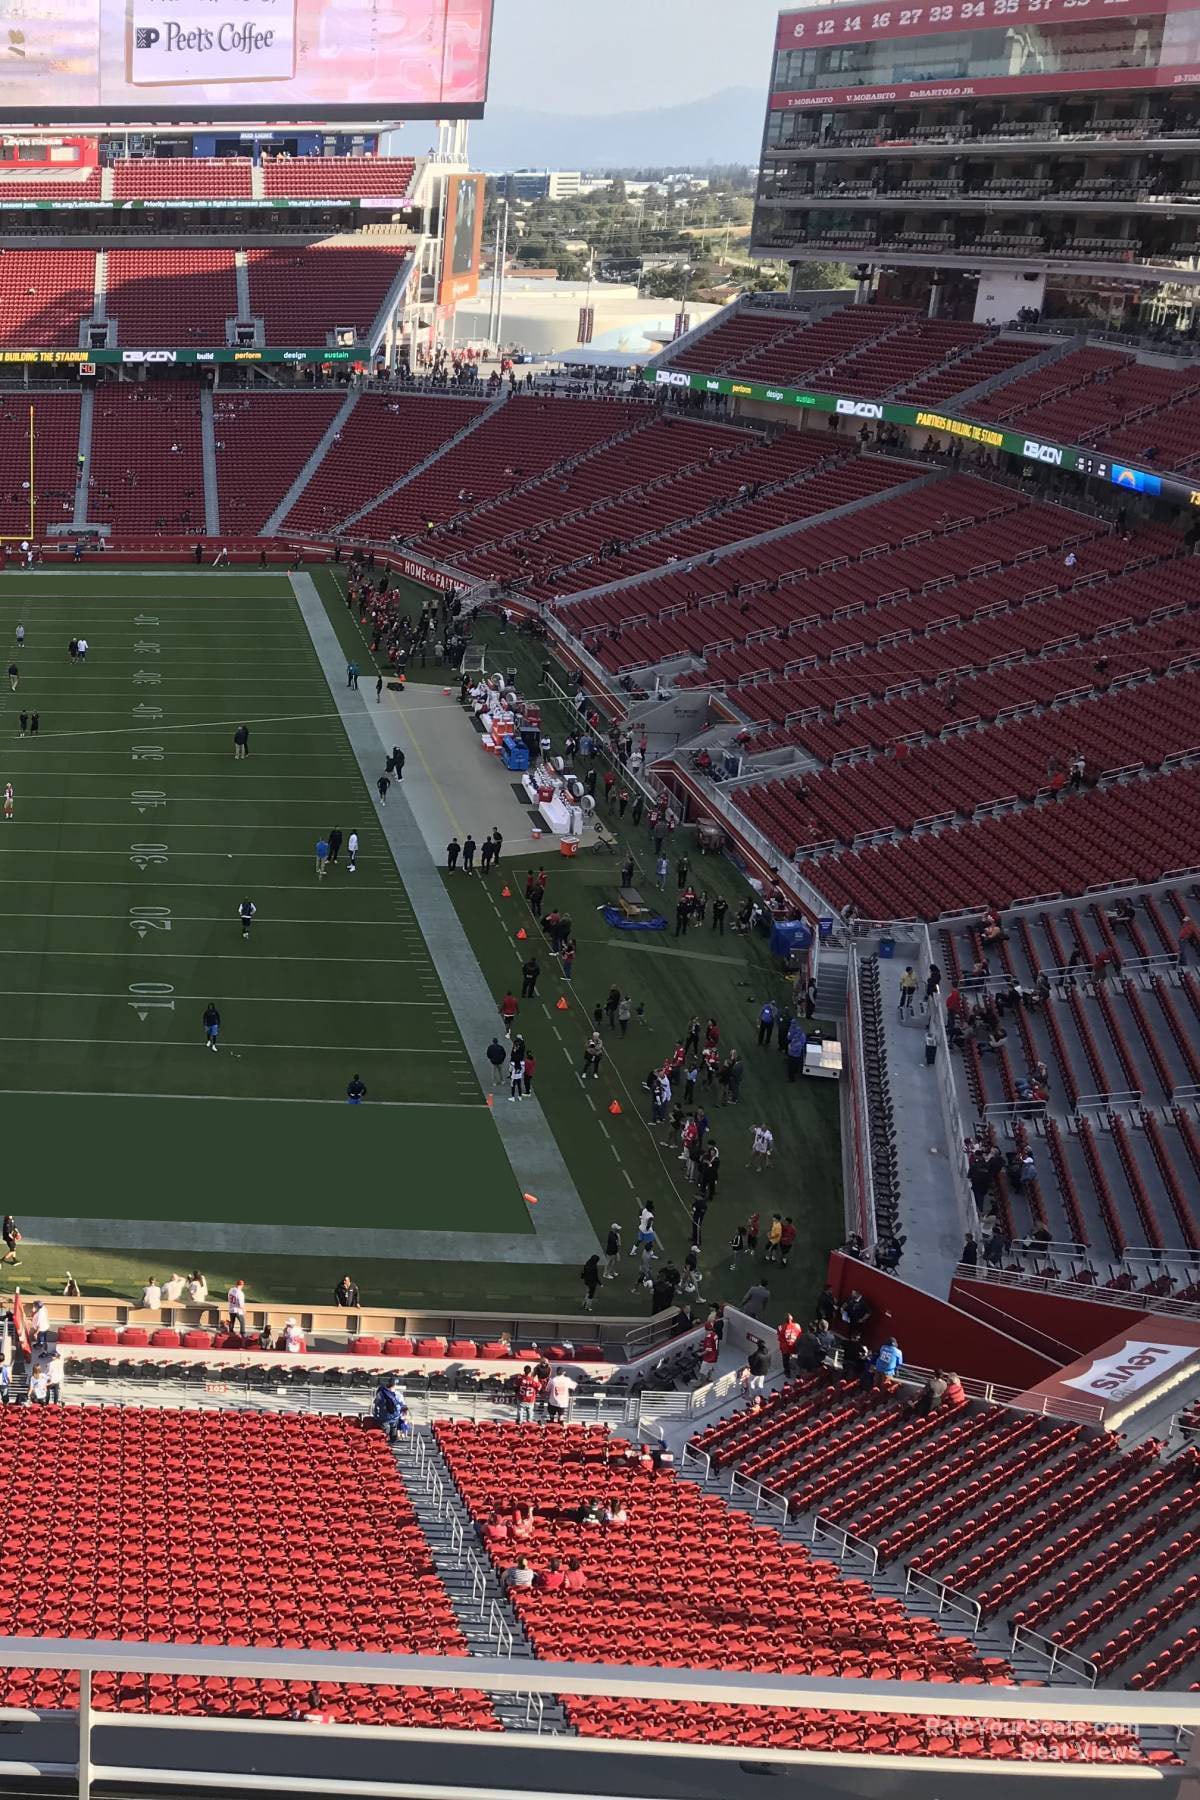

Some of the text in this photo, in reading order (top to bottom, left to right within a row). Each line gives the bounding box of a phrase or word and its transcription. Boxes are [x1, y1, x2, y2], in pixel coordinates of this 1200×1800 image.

[794, 24, 805, 37] 8
[816, 20, 835, 35] 12
[843, 16, 861, 31] 14
[872, 12, 891, 28] 16
[899, 9, 923, 25] 27
[929, 5, 953, 22] 33
[960, 1, 985, 18] 34
[993, 0, 1019, 15] 35
[163, 22, 274, 54] Peet's Coffee
[5, 352, 38, 361] BUILDING
[40, 352, 54, 361] THE
[55, 351, 88, 361] STADIUM
[197, 352, 214, 360] build
[234, 353, 261, 361] perform
[283, 352, 307, 361] design
[81, 364, 94, 374] 40
[732, 384, 752, 395] perform
[766, 389, 784, 400] design
[404, 560, 426, 581] HOME
[131, 746, 164, 760] 50
[130, 790, 167, 807] 40
[129, 843, 169, 863] 30
[129, 906, 172, 930] 20
[128, 982, 175, 1010] 10
[519, 1385, 534, 1397] 52
[494, 1396, 510, 1404] 101
